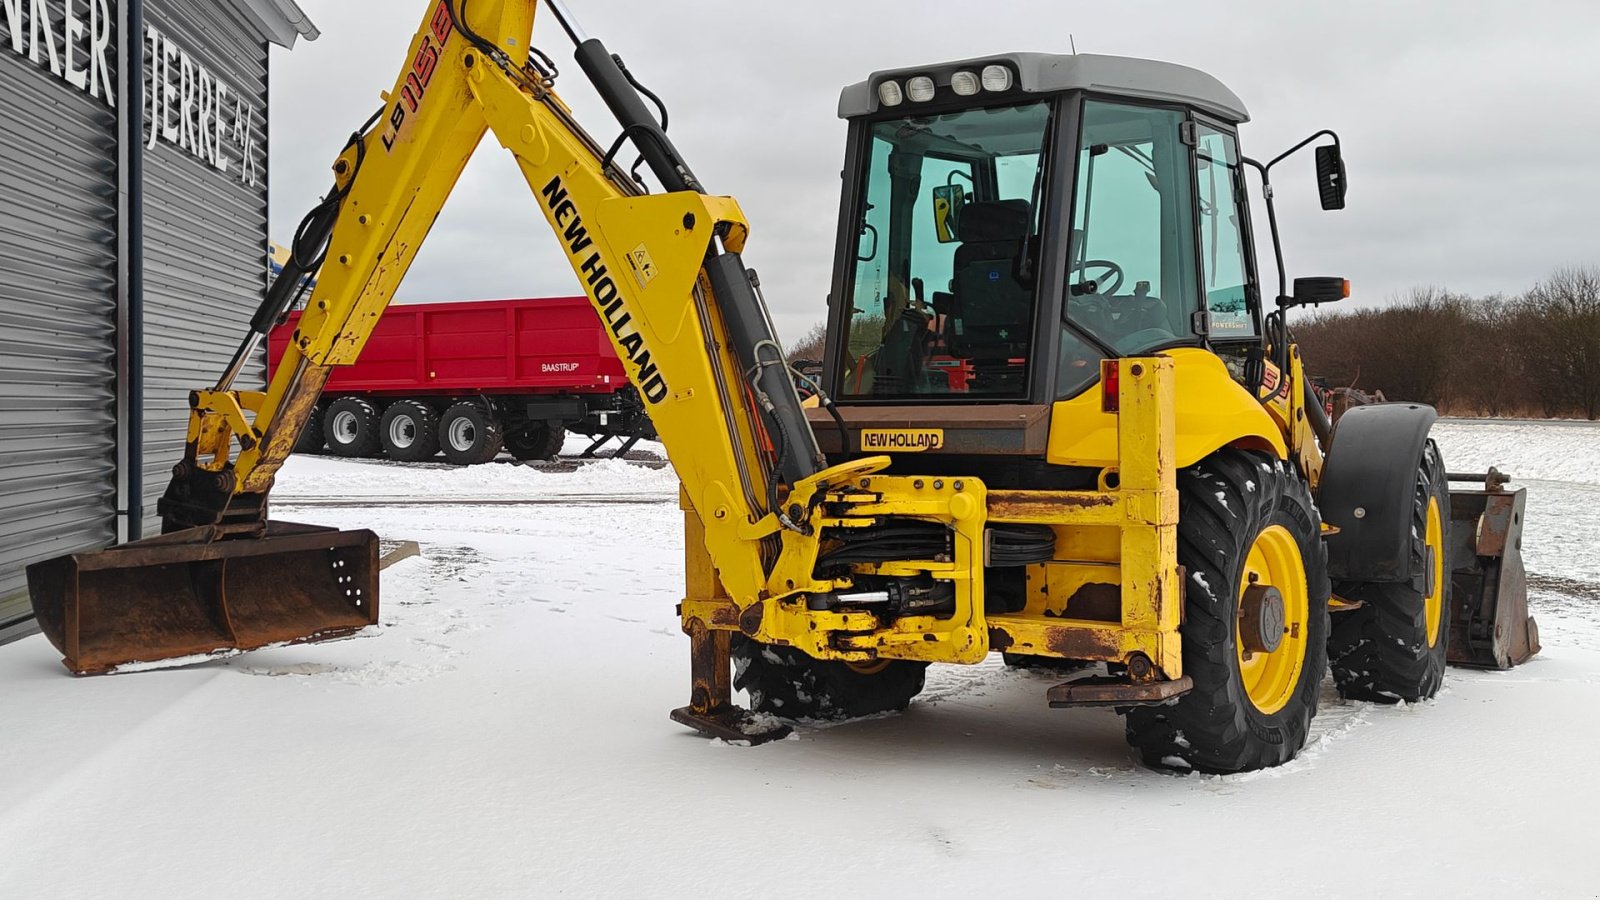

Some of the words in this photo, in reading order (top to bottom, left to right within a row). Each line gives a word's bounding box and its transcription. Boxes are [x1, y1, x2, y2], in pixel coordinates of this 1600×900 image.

[142, 25, 227, 172] JERRE
[233, 95, 255, 187] A/S
[542, 175, 592, 254] NEW
[580, 252, 668, 404] HOLLAND
[864, 433, 887, 447] NEW
[888, 433, 939, 447] HOLLAND
